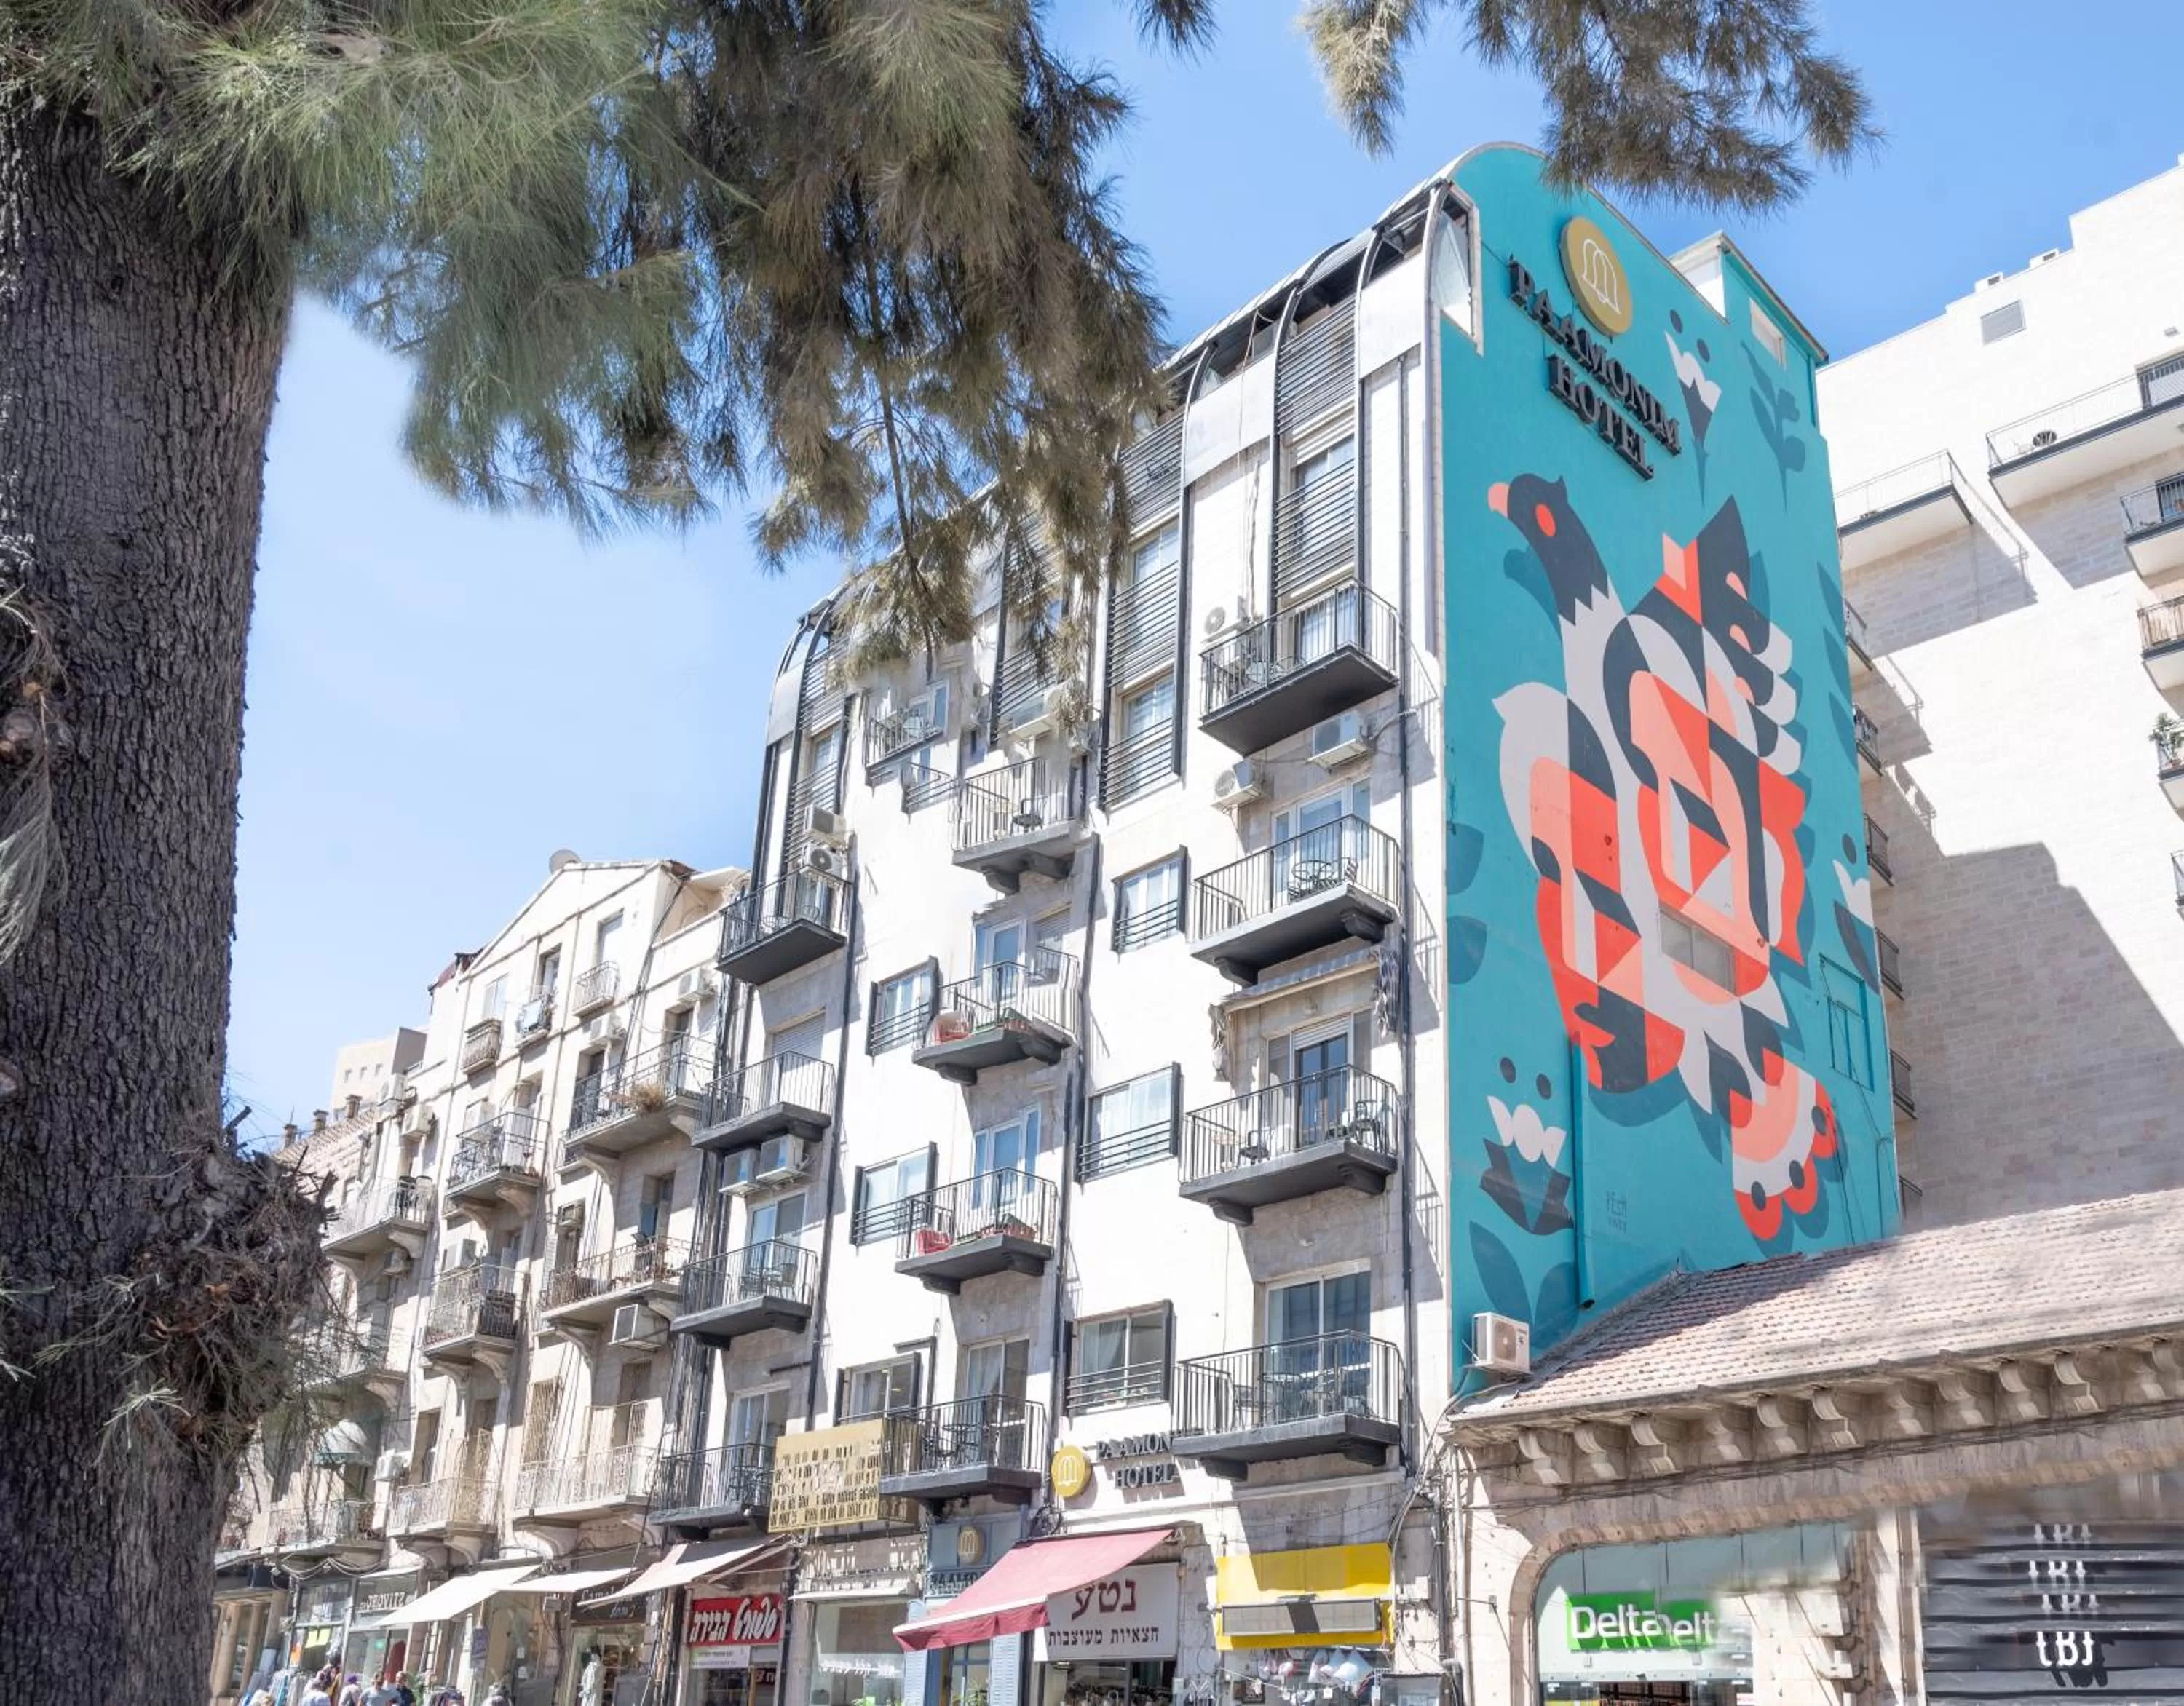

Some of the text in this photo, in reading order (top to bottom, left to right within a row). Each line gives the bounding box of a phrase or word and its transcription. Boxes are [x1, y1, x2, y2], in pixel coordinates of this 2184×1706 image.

[1508, 258, 1682, 457] PAAMONIM
[1546, 354, 1654, 482] HOTEL
[1096, 1432, 1173, 1459] PAAMON
[1115, 1463, 1176, 1488] HOTEL
[1071, 1578, 1136, 1621] נטע
[689, 1609, 732, 1643] הבירה
[1048, 1627, 1159, 1646] חצאיות מעוצבות
